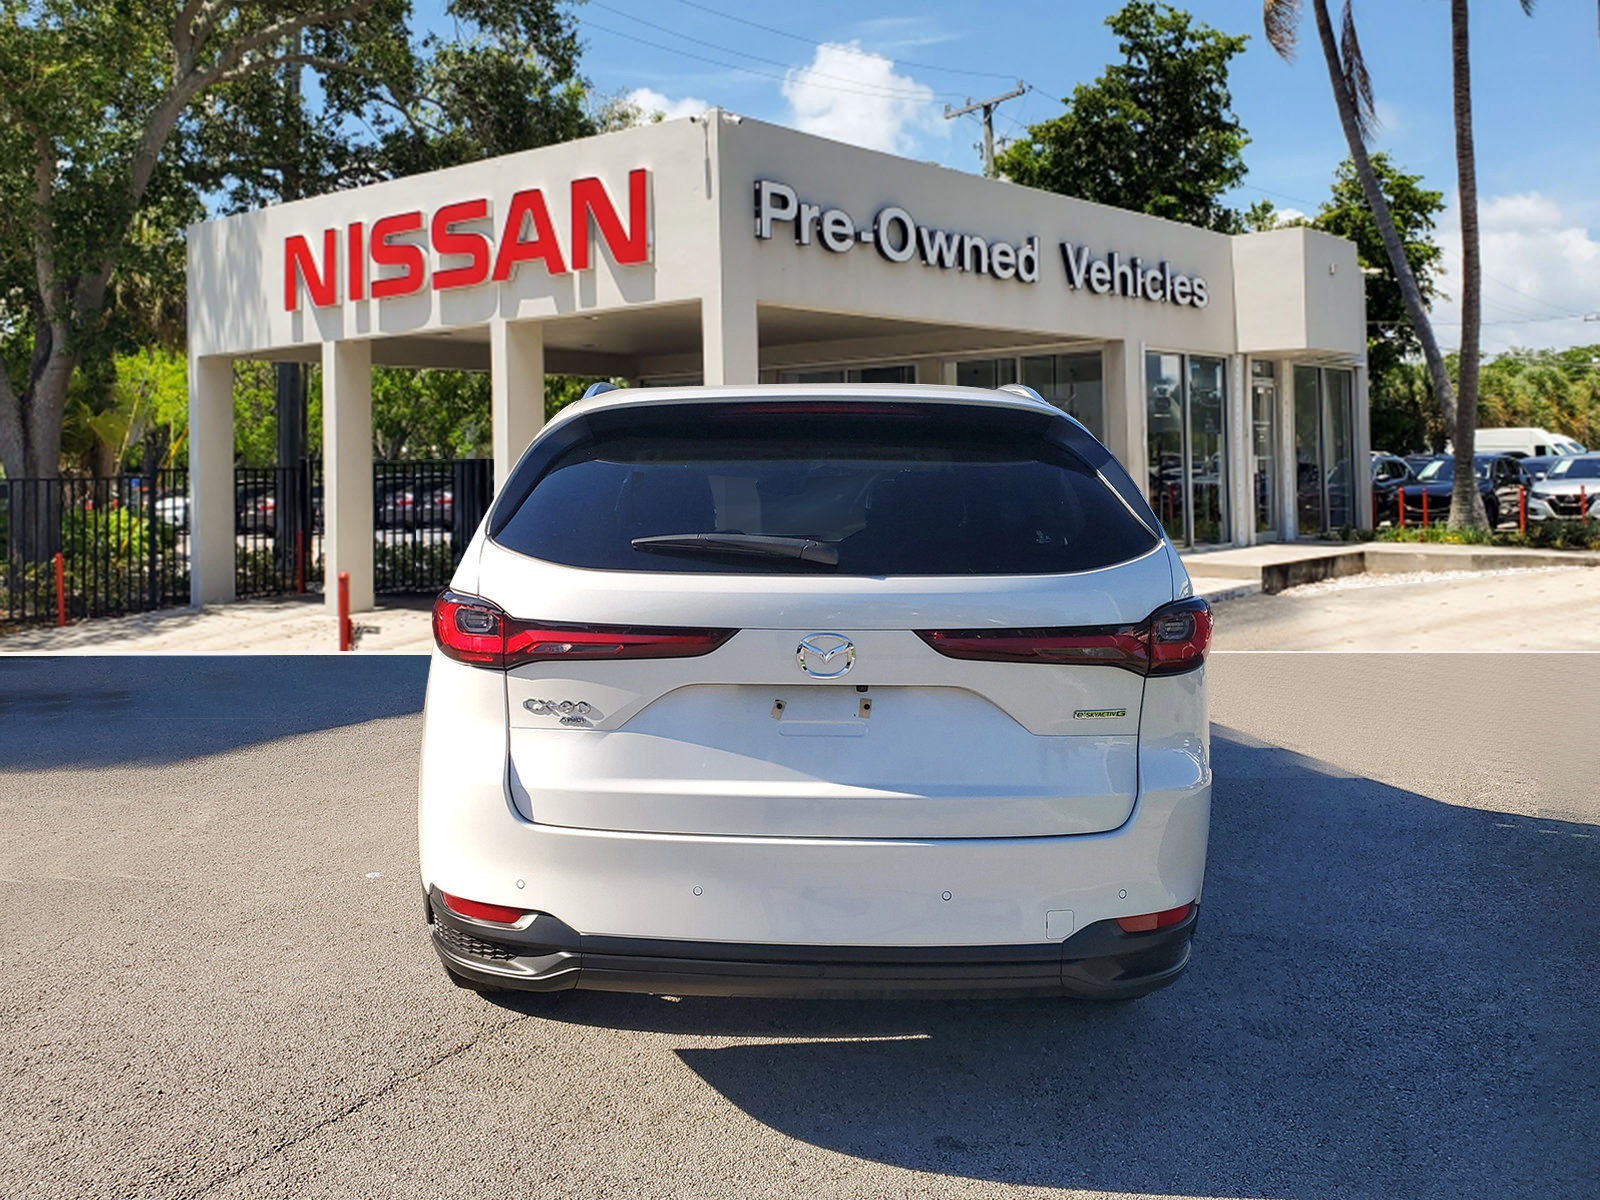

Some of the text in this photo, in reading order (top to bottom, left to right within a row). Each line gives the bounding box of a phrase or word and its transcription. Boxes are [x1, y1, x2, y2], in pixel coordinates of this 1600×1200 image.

[285, 168, 648, 312] NISSAN
[754, 180, 1209, 309] Pre-Owned Vehicles
